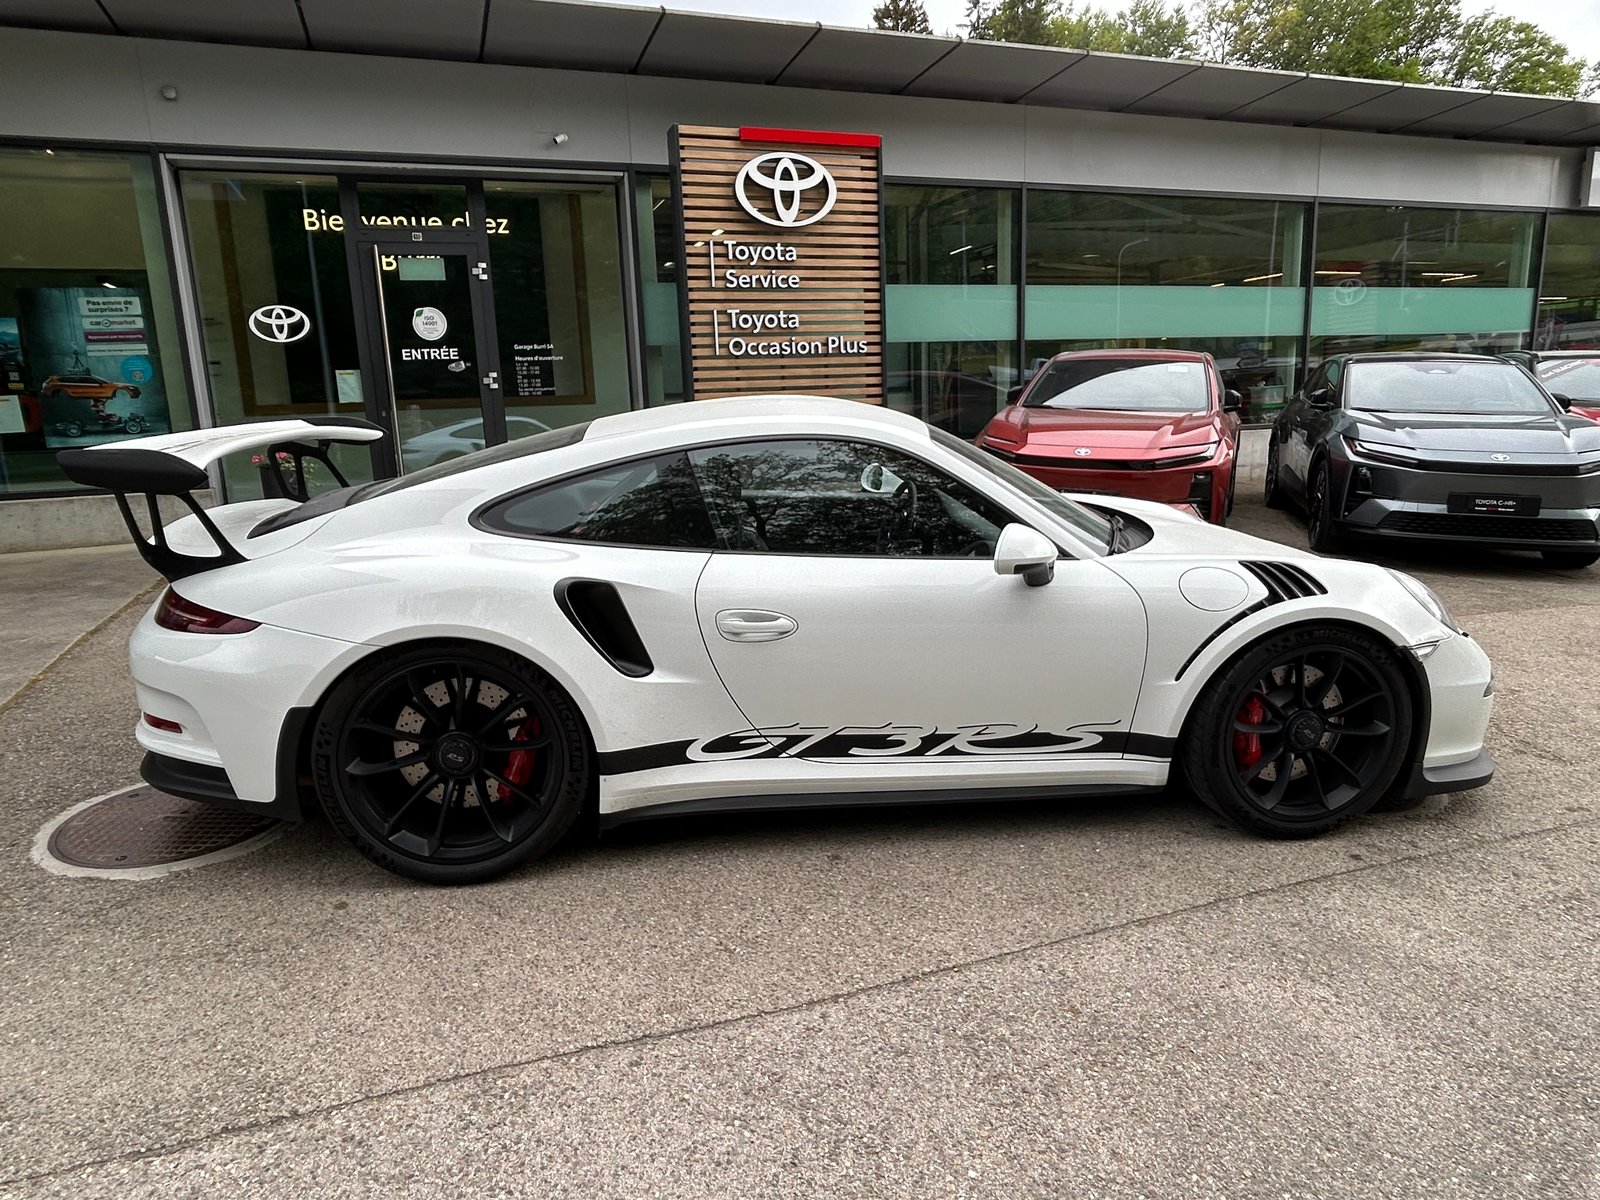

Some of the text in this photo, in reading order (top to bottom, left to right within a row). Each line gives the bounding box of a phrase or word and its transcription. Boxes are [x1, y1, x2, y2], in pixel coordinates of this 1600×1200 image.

[302, 209, 443, 231] Bievenue
[723, 240, 798, 265] Toyota
[725, 269, 800, 289] Service
[727, 309, 800, 334] Toyota
[402, 346, 459, 360] ENTRÉE
[728, 336, 868, 356] Occasion Plus
[546, 686, 585, 773] MICHELIN
[686, 719, 1122, 762] GT3 RS
